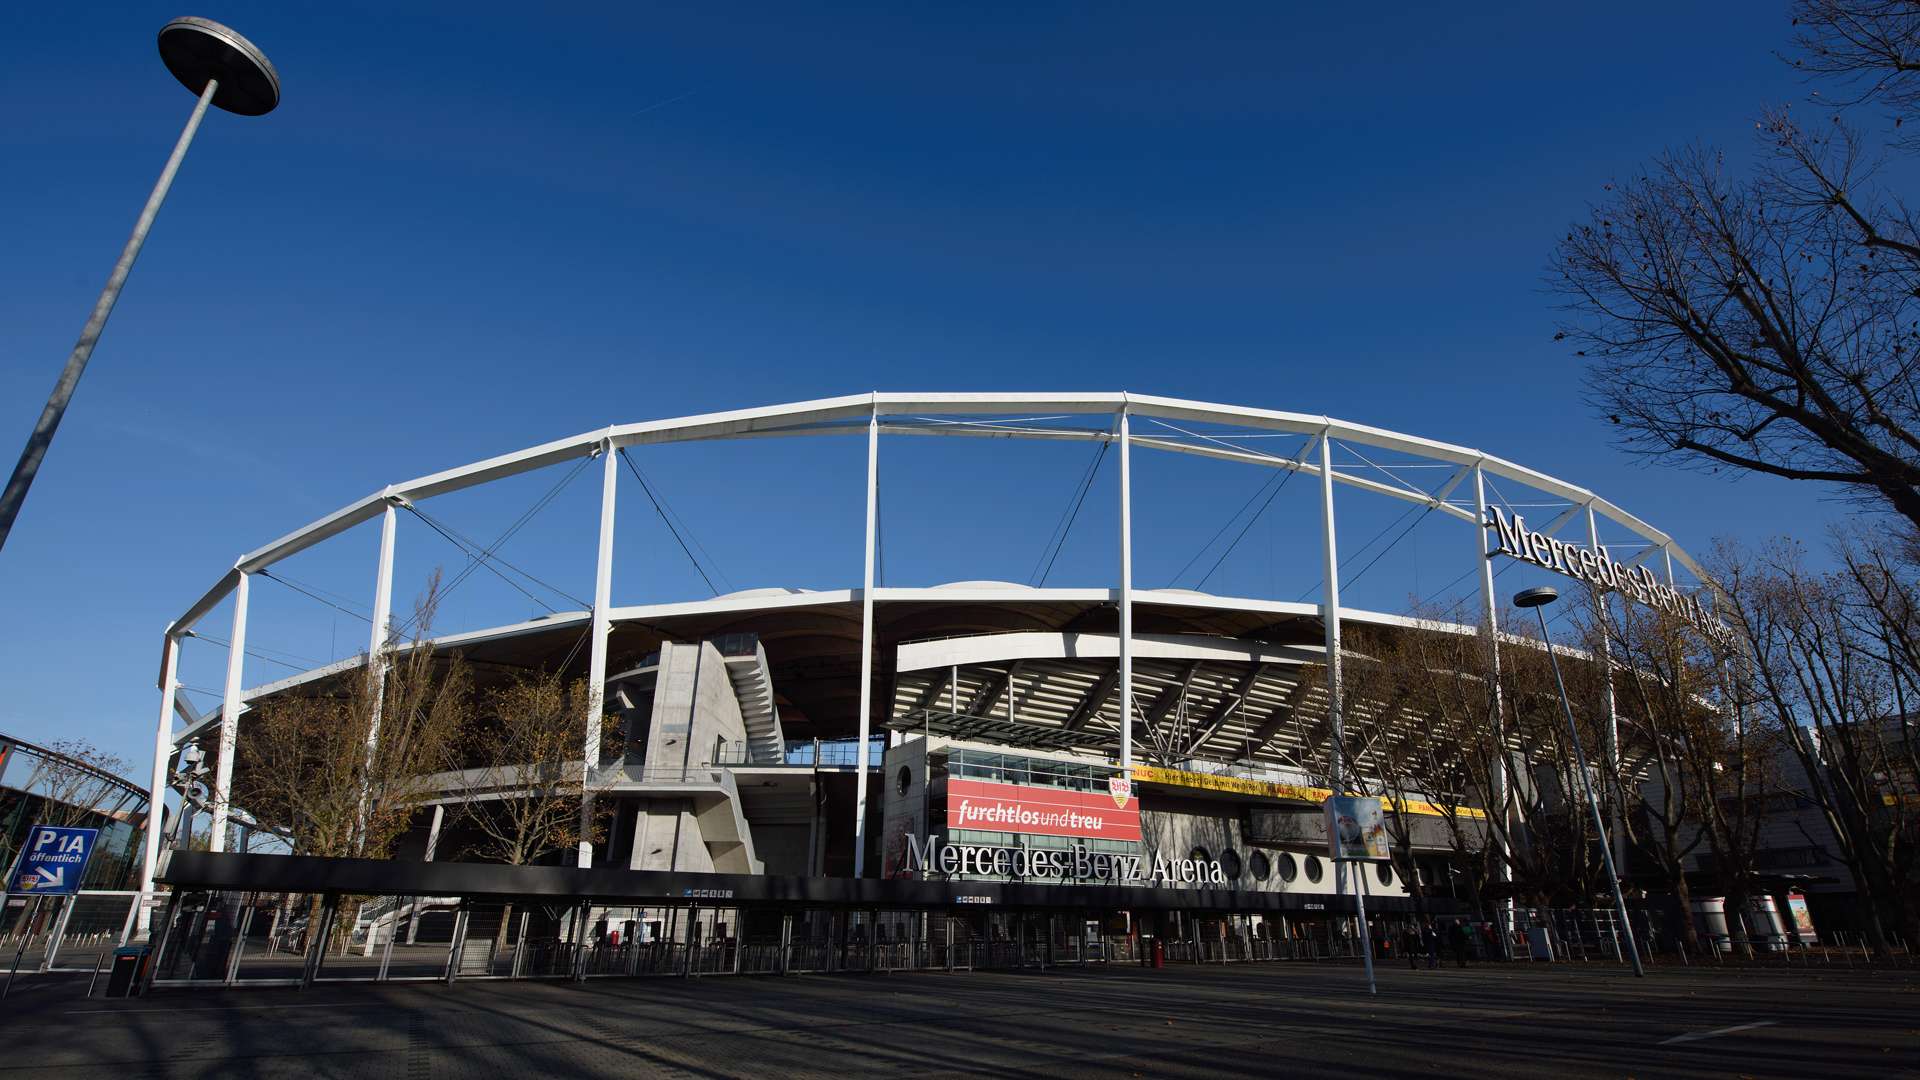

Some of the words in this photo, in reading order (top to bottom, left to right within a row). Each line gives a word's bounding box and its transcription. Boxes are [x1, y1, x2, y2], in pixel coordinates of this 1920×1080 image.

[1490, 505, 1699, 628] Mercedes-Benz
[1133, 769, 1154, 778] NUC
[34, 830, 57, 851] P
[58, 835, 84, 854] 1A
[29, 852, 82, 863] öffentlich
[903, 833, 1142, 880] Mercedes-Benz
[1150, 848, 1224, 884] Arena
